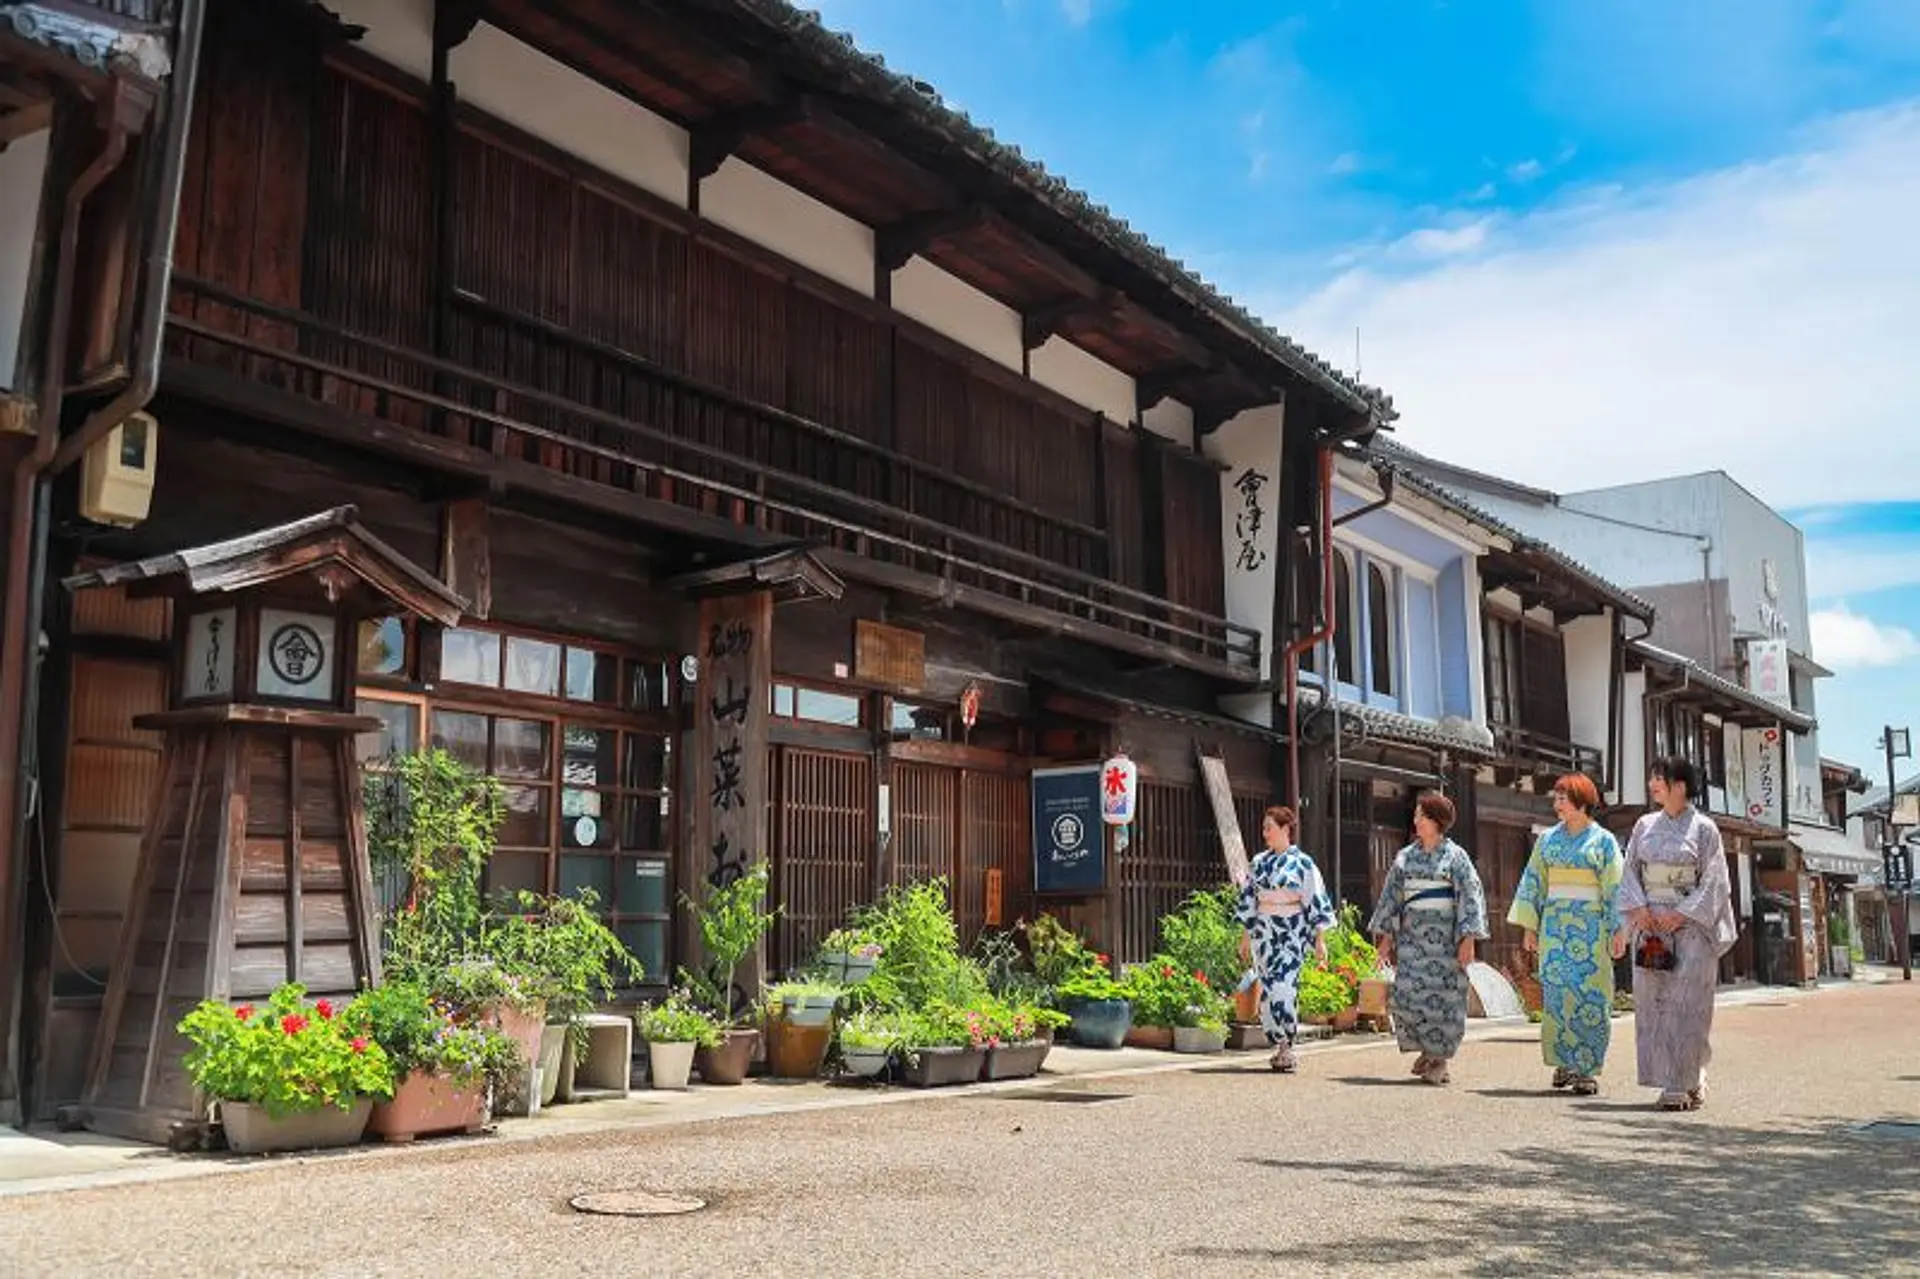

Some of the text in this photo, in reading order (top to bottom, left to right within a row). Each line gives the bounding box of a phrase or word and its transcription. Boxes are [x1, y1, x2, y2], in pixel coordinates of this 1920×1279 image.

[1233, 467, 1269, 573] 會津屋
[1104, 766, 1128, 795] 氷
